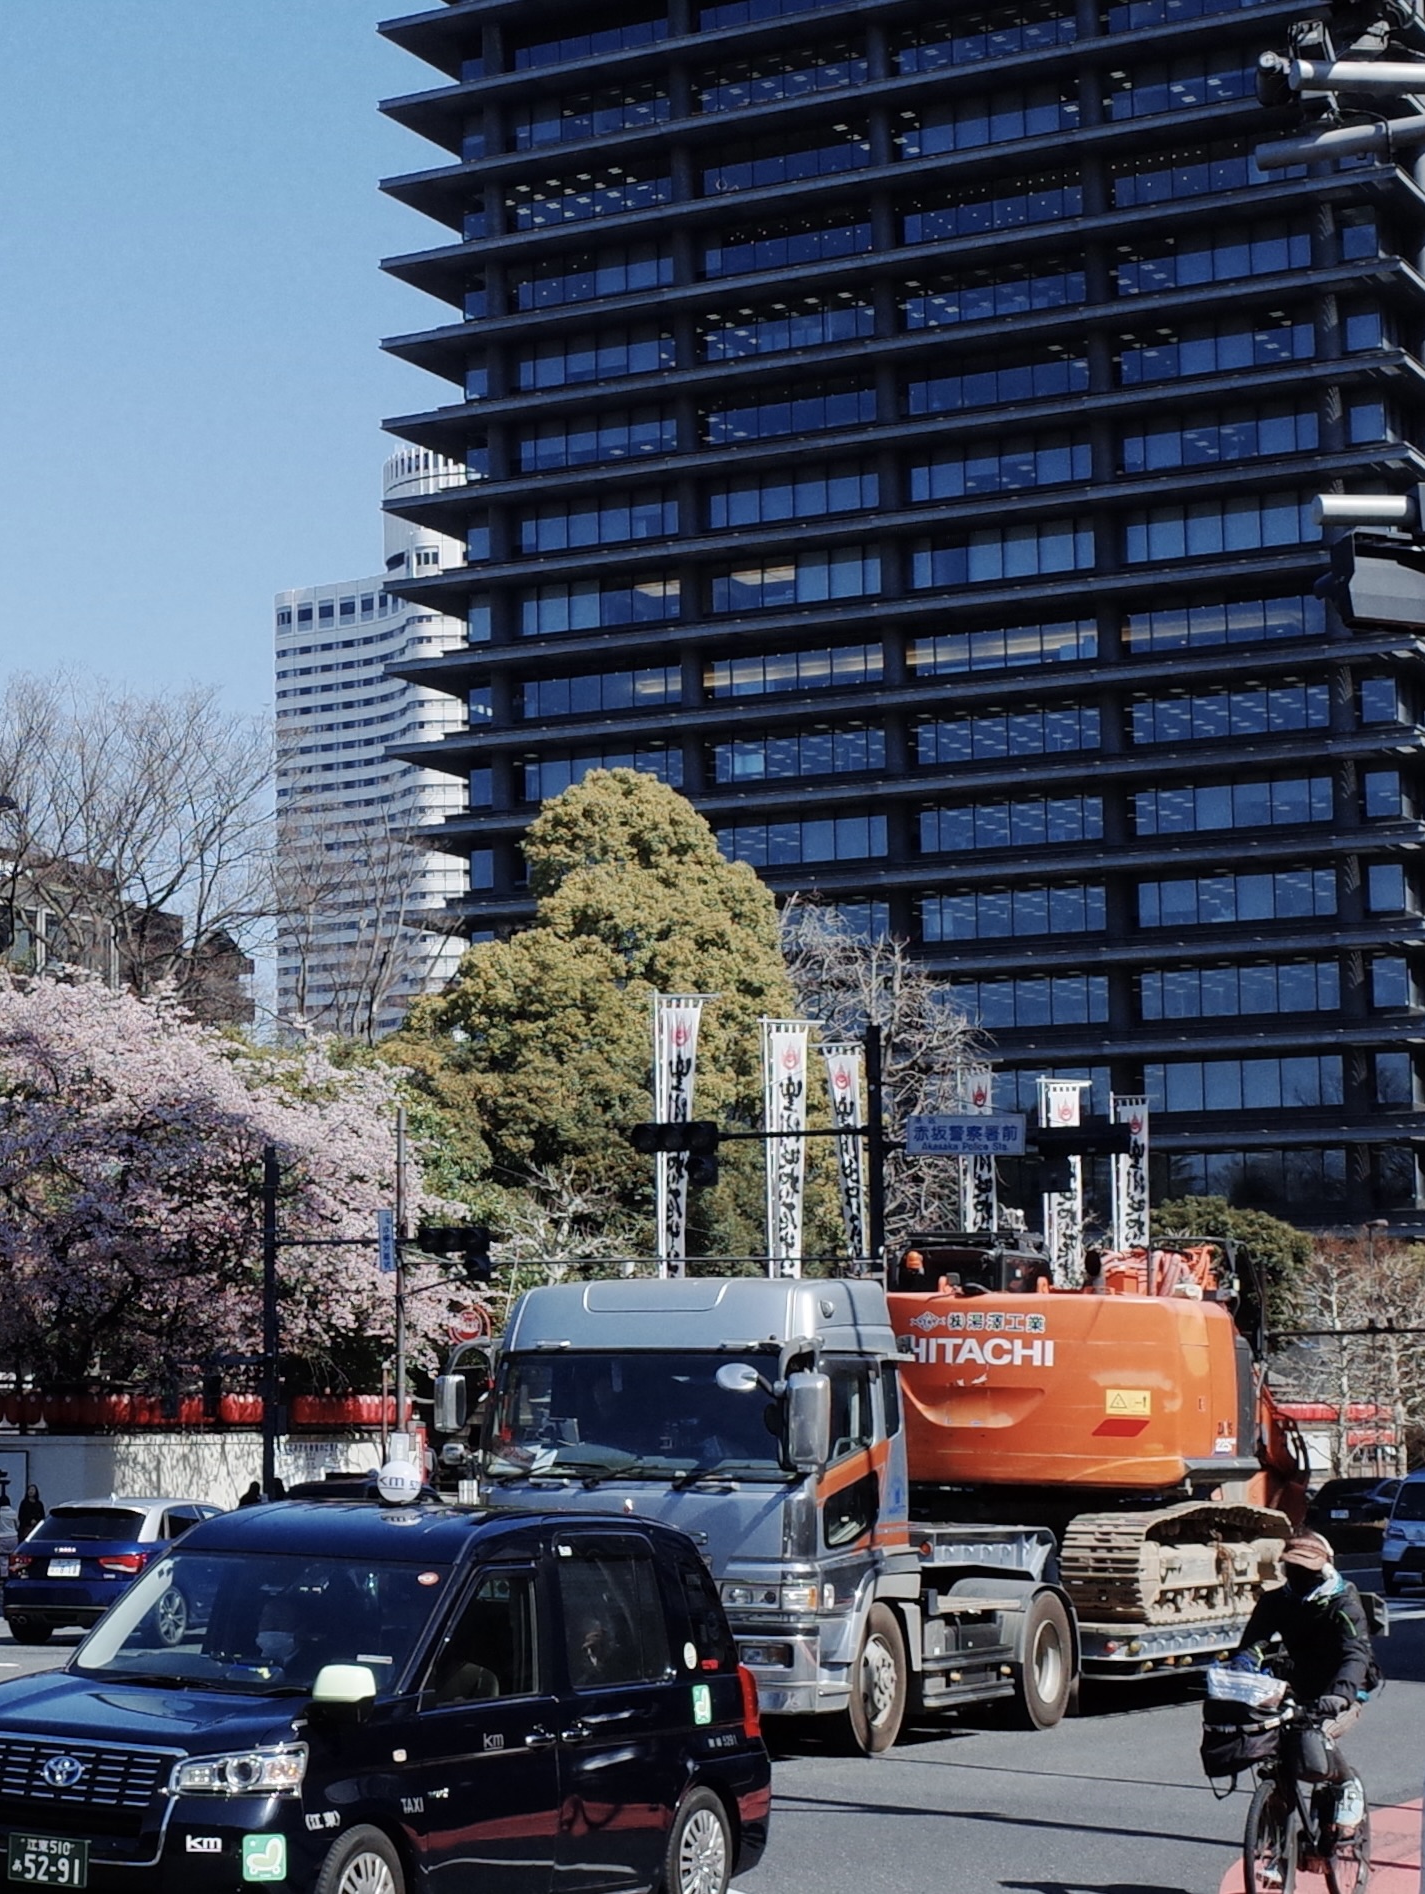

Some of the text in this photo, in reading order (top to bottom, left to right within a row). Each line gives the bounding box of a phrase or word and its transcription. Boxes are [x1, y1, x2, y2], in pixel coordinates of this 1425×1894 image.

[914, 1125, 1018, 1142] 赤坂警察署前
[921, 1142, 959, 1151] Akasaka
[962, 1142, 989, 1151] Police
[913, 1337, 1055, 1366] HITACHI
[483, 1733, 504, 1751] km
[400, 1797, 424, 1814] TAXI
[185, 1834, 222, 1852] km
